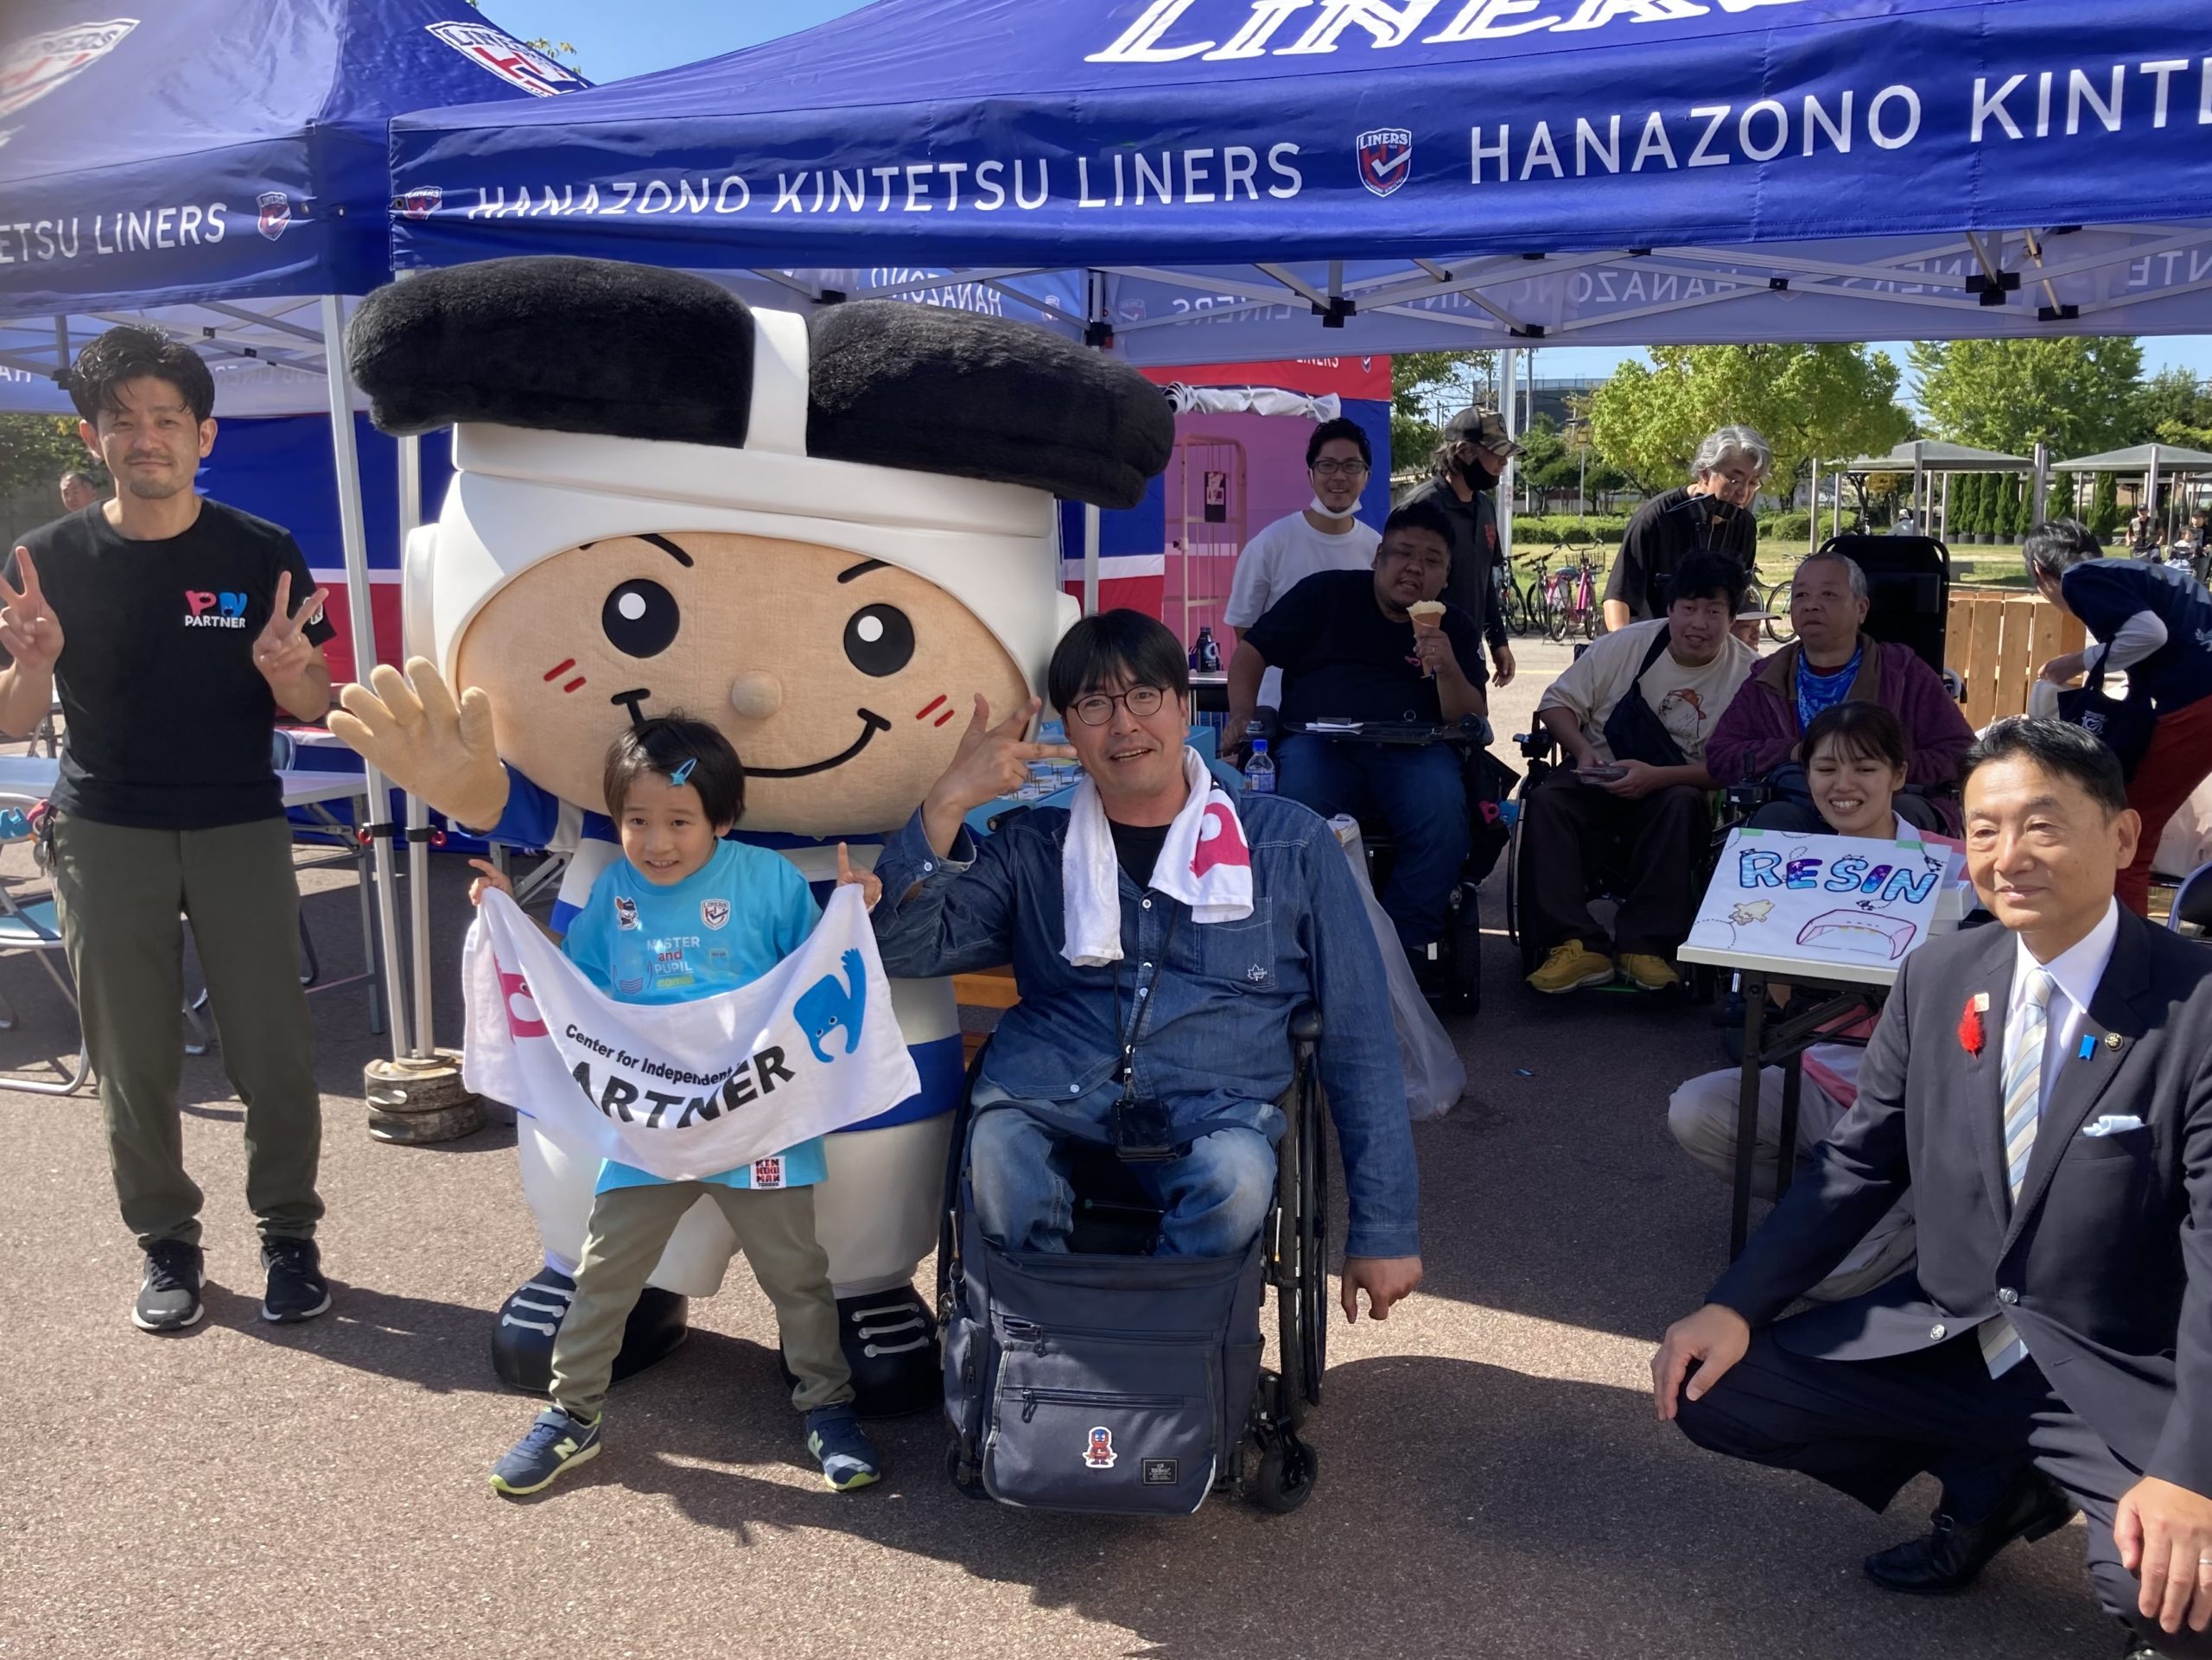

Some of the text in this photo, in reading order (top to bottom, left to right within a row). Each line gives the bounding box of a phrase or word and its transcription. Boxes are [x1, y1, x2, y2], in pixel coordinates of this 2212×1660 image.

[1360, 133, 1408, 149] LINERS
[1471, 85, 1921, 184] HANAZONO
[468, 143, 1302, 219] HANAZONO KINTETSU LINERS
[95, 203, 227, 254] LINERS
[184, 614, 246, 629] PARTNER
[1739, 850, 1939, 904] RESIN
[654, 961, 694, 975] PUPIL
[658, 949, 683, 962] and
[566, 1024, 614, 1059] Center
[617, 1050, 639, 1070] for
